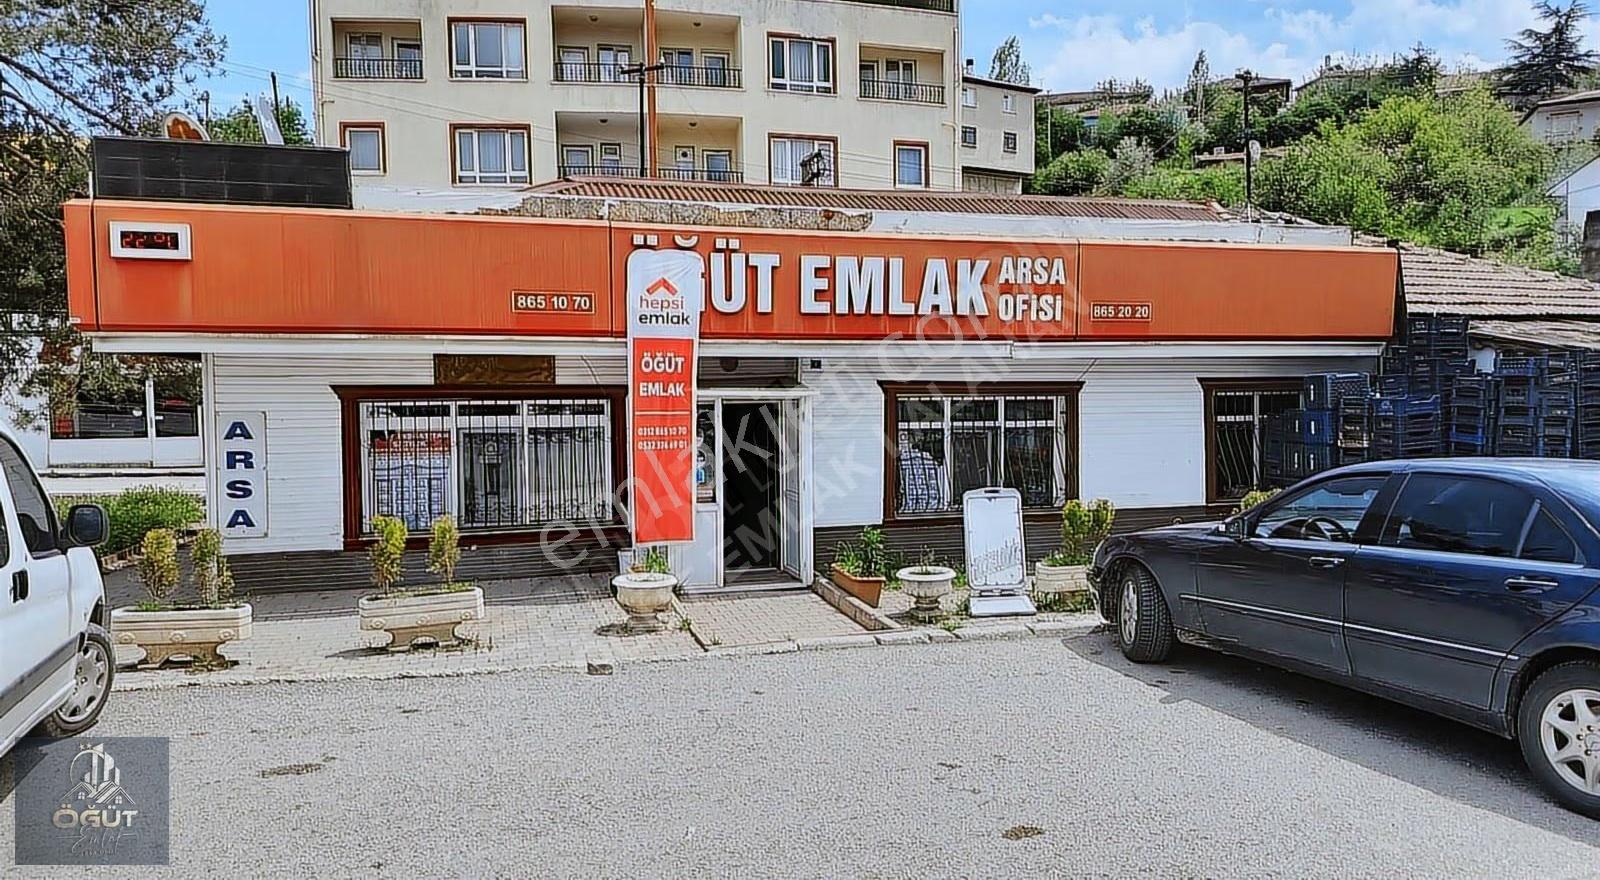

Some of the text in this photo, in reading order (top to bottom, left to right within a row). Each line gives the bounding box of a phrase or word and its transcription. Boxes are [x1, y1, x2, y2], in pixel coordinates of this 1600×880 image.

[632, 233, 990, 317] ÜT EMLAK
[998, 256, 1066, 285] ARSA
[516, 294, 590, 310] 865 10 70
[639, 294, 685, 312] hepsi
[638, 312, 690, 326] emlak
[1093, 305, 1149, 318] 865 20 20
[641, 352, 685, 373] ÖĞÜT
[639, 382, 686, 397] EMLAK
[223, 420, 256, 529] ARSA
